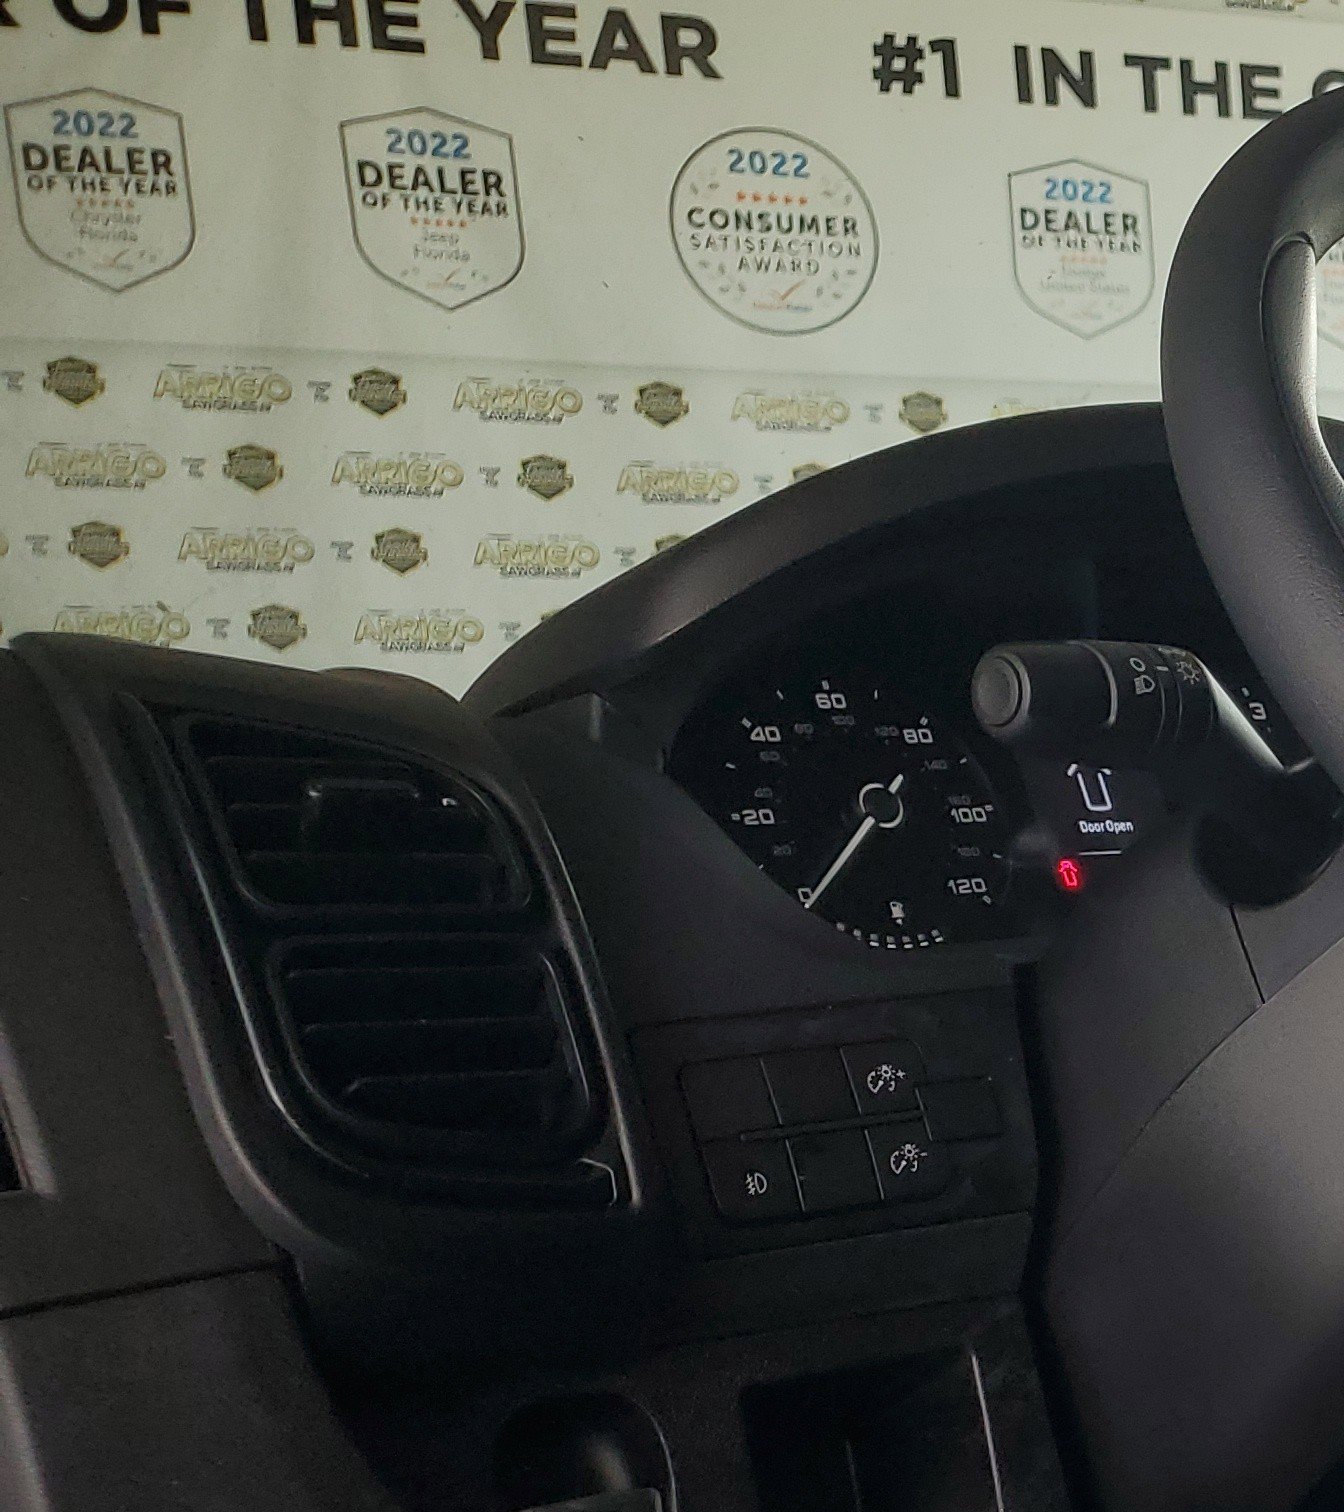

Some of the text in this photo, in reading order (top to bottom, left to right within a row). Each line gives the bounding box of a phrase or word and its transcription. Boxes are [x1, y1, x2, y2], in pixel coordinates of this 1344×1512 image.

[450, 0, 724, 79] YEAR
[872, 32, 962, 98] #1
[1013, 44, 1097, 109] IN
[1124, 53, 1284, 120] THE
[53, 108, 139, 139] 2022
[386, 127, 472, 159] 2022
[22, 141, 174, 177] DEALER
[728, 148, 811, 180] 2022
[27, 173, 178, 198] OF THE YEAR
[357, 159, 507, 198] DEALER
[1045, 177, 1113, 205] 2022
[362, 190, 509, 219] OF THE YEAR
[687, 206, 860, 239] CONSUMER
[1020, 207, 1139, 236] DEALER
[689, 233, 861, 259] SATISFACTION
[738, 256, 820, 277] AWARD
[473, 536, 601, 571] ARRIGO
[353, 611, 485, 646] ARRIGO
[815, 692, 847, 710] 60
[1249, 702, 1267, 720] 3
[750, 726, 782, 744] 40
[903, 728, 934, 745] 80
[741, 808, 775, 827] 20
[951, 808, 989, 824] 100
[1079, 820, 1134, 835] Door Open
[947, 878, 988, 896] 120
